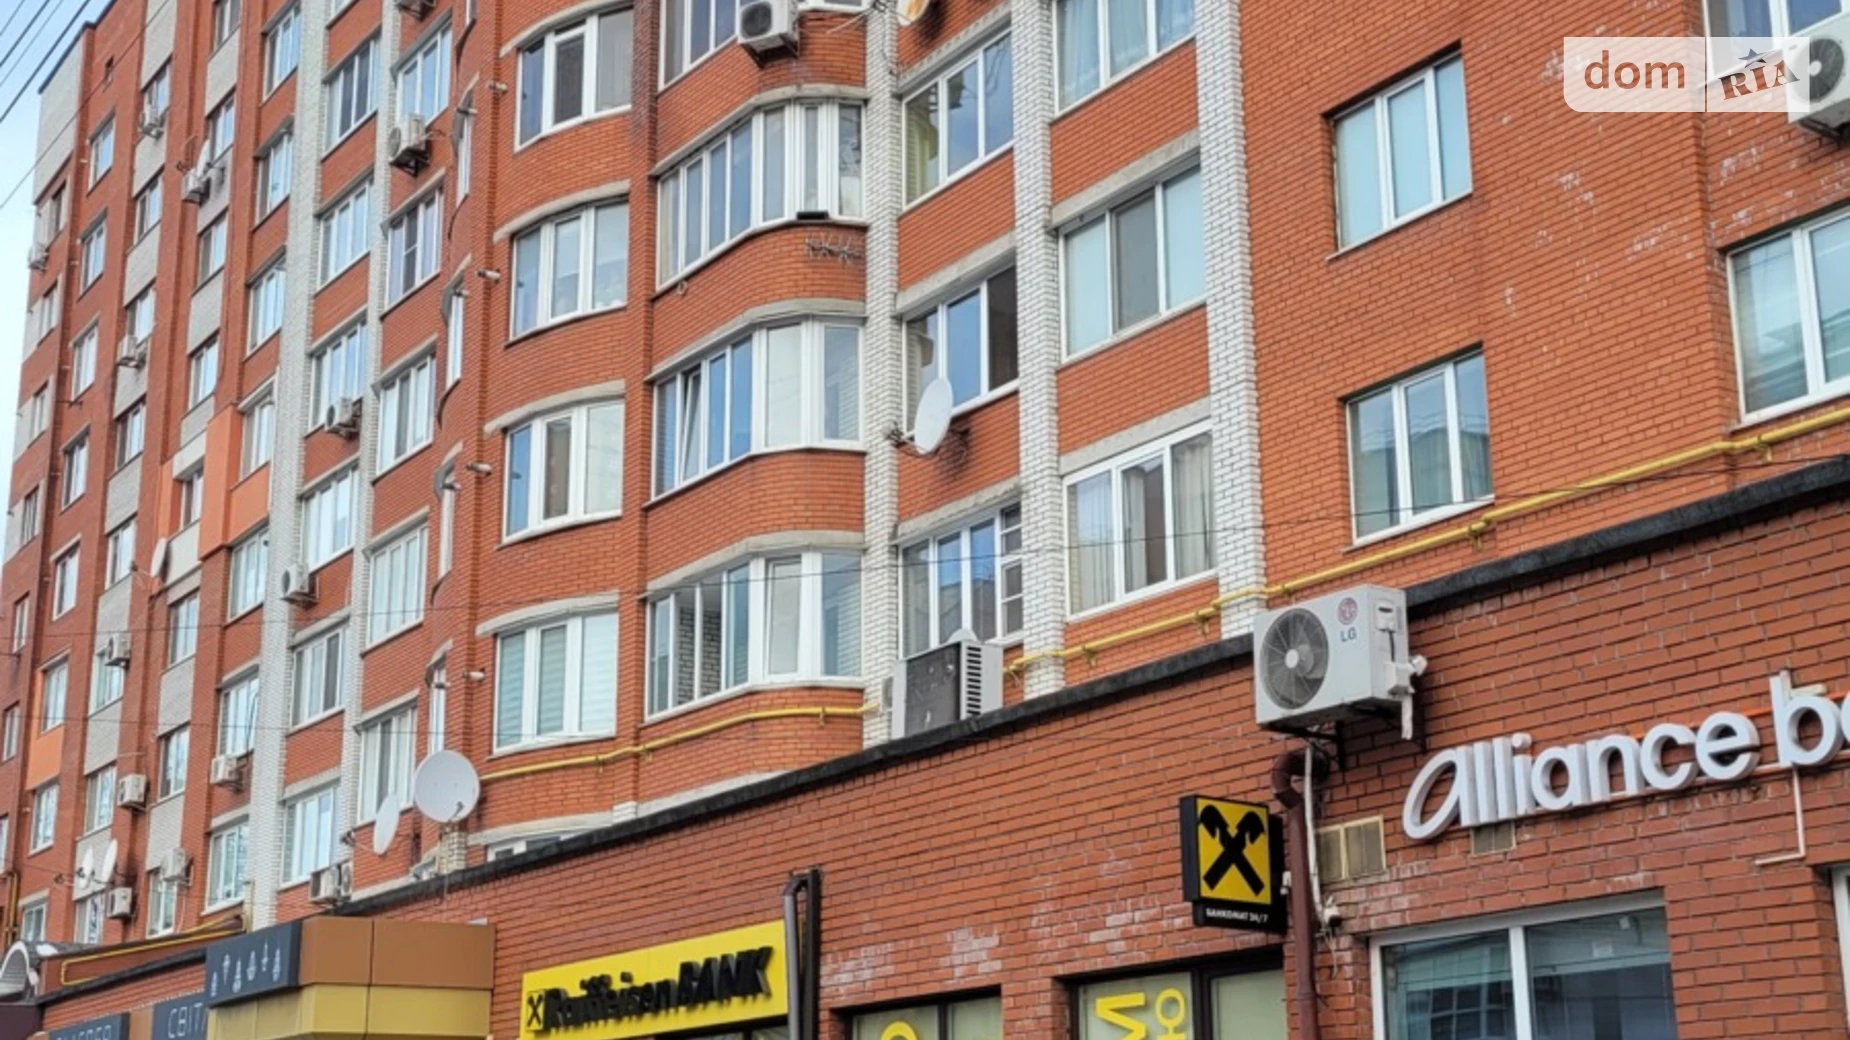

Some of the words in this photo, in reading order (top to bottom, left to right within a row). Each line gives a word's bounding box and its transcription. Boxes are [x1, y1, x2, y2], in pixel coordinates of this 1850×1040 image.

[1340, 627, 1357, 642] LG
[1403, 711, 1759, 839] alliance
[677, 946, 774, 1010] BANK
